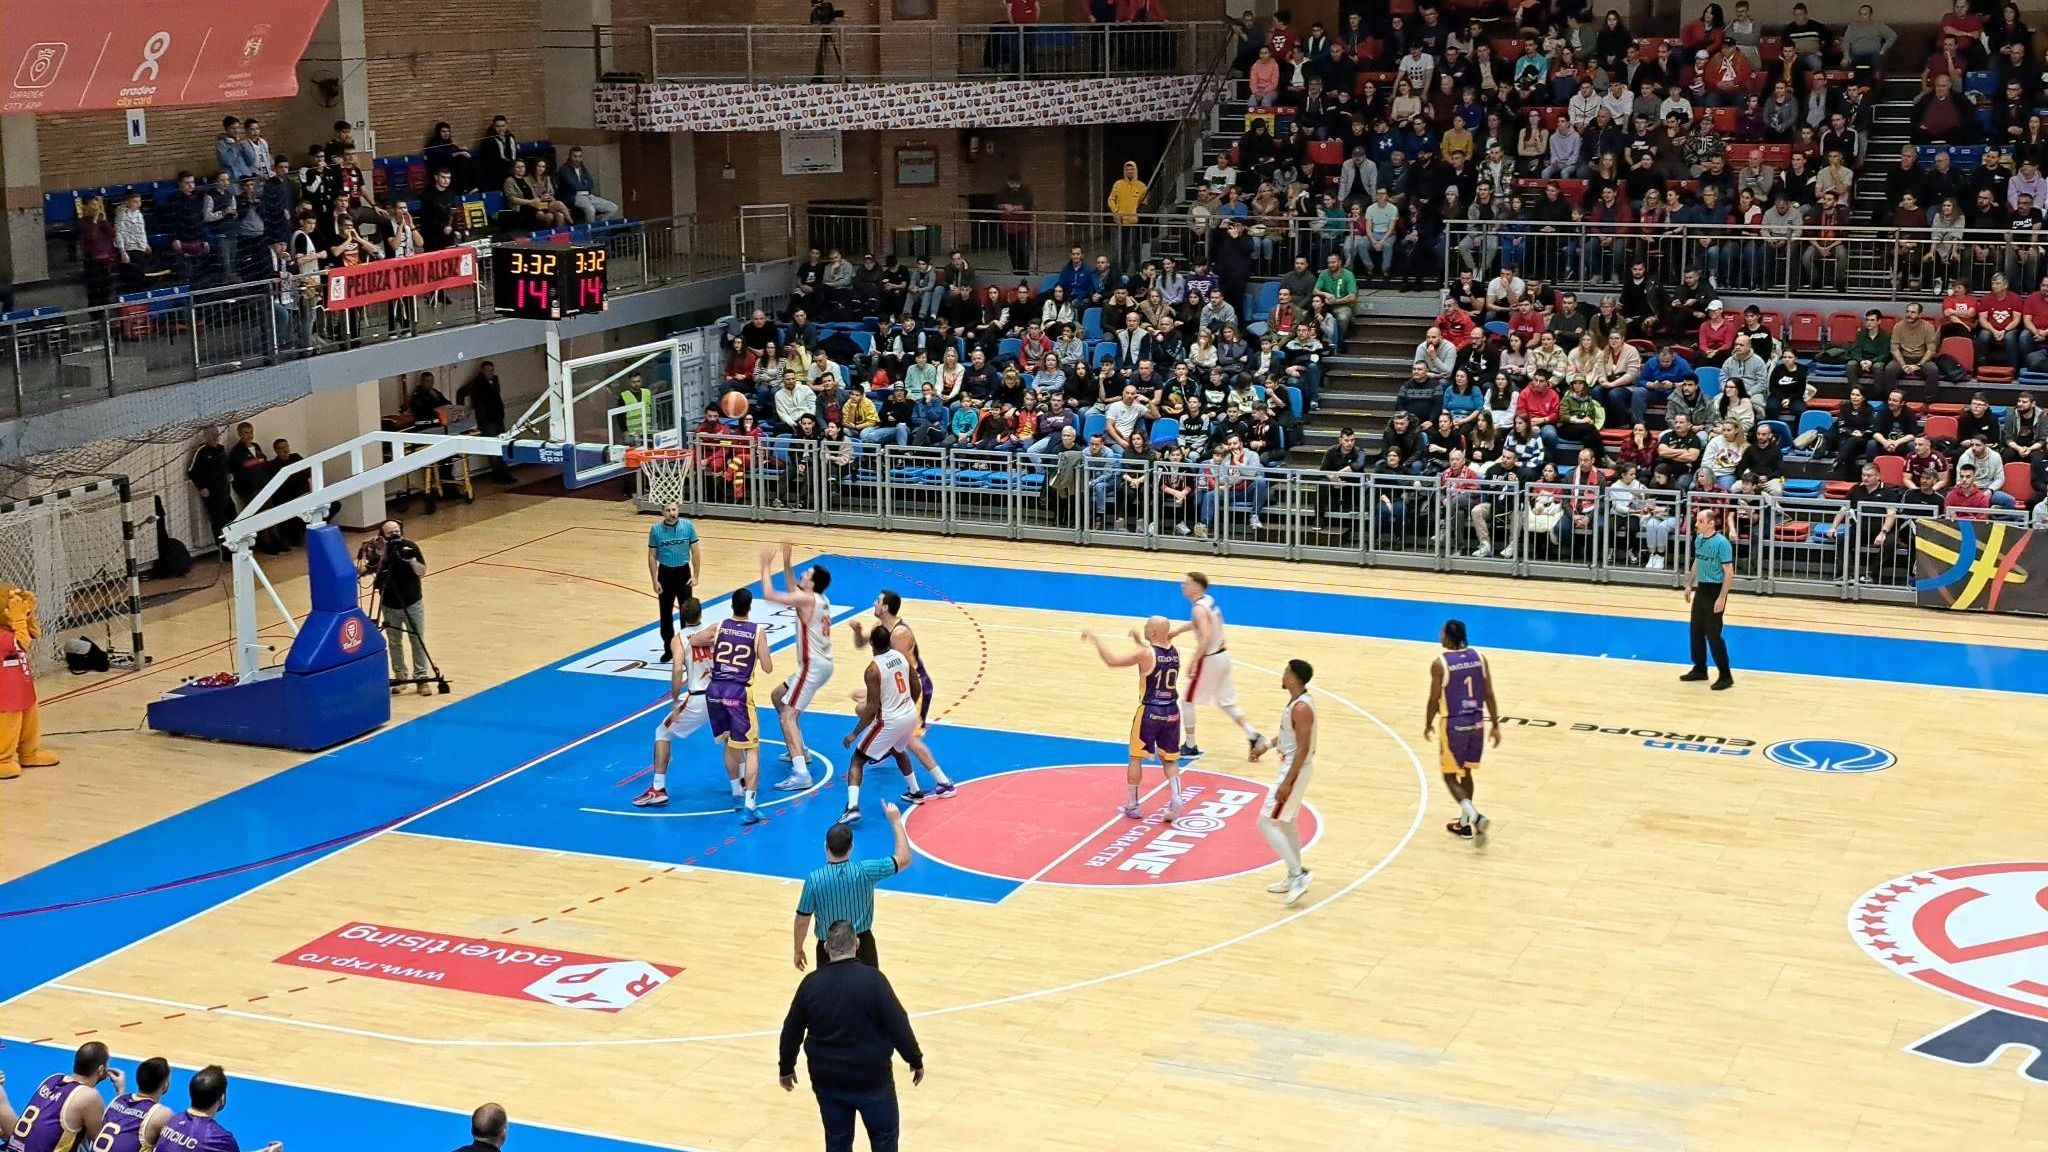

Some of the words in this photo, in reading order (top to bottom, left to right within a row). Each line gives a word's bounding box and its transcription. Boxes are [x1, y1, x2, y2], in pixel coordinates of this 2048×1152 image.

[132, 119, 141, 137] N
[393, 261, 426, 289] TONI
[510, 253, 557, 276] 3:32
[575, 249, 605, 274] 3:32
[517, 279, 548, 309] 14
[580, 276, 601, 307] 14
[716, 641, 751, 667] 22
[894, 671, 907, 694] 6
[1154, 668, 1178, 690] 10
[1463, 676, 1474, 698] 1
[1569, 723, 1757, 747] EUROPE
[1643, 739, 1751, 757] FIBA
[1116, 788, 1261, 876] PROLINE
[1083, 825, 1150, 868] CARACTER
[338, 925, 564, 967] advertising
[297, 953, 446, 981] www.rxp.ro
[14, 1105, 41, 1138] 8
[92, 1121, 121, 1152] 6
